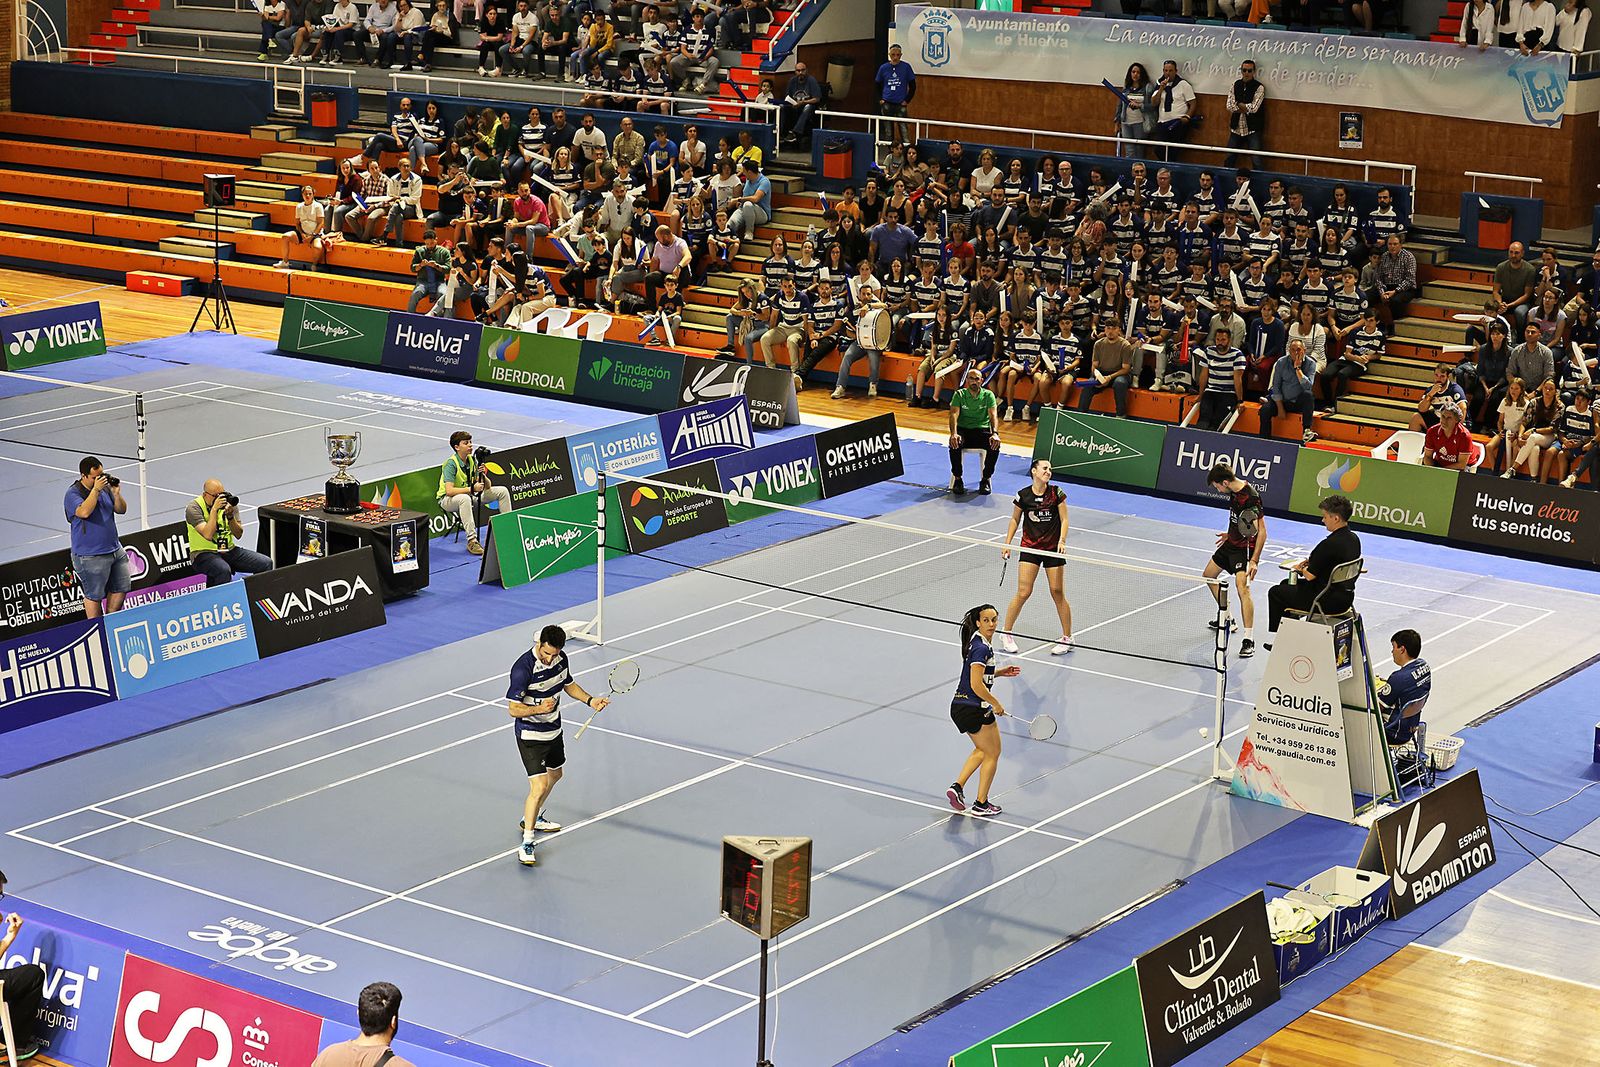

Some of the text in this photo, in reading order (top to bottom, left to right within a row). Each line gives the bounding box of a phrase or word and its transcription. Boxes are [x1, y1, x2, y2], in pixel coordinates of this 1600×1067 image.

[966, 16, 1070, 33] Ayuntamiento
[994, 33, 1069, 48] de Huelva
[1105, 24, 1465, 80] La emoción de ganar debe ser mayor
[1182, 56, 1203, 75] al
[1270, 62, 1289, 86] de
[43, 319, 97, 349] YONEX
[395, 324, 462, 355] Huelva
[435, 354, 459, 366] original
[615, 361, 671, 380] Fundación
[492, 367, 565, 391] IBERDROLA
[613, 373, 653, 392] Unicaja
[751, 400, 782, 410] ESPAÑA
[601, 432, 658, 459] LOTERÍAS
[826, 433, 892, 467] OKEYMAS
[1055, 433, 1121, 456] El Corte Inglés
[509, 454, 560, 481] Andalucía
[611, 461, 623, 470] CON
[631, 453, 655, 464] DEPORTE
[828, 452, 895, 479] FITNESS CLUB
[1176, 441, 1271, 481] Huelva
[511, 474, 564, 492] Región Europea del
[760, 456, 815, 496] YONEX
[513, 488, 546, 501] DEPORTE
[665, 497, 714, 517] Región Europea del
[667, 511, 698, 526] DEPORTE
[1351, 501, 1426, 528] RDROLA
[1475, 492, 1579, 524] Huelva eleva
[525, 527, 581, 551] El Corte Inglés
[1471, 513, 1576, 544] tus sentidos.
[6, 585, 85, 618] DE HUELVA
[264, 574, 374, 619] VANDA
[9, 607, 58, 628] OBJETIVOS
[157, 602, 244, 640] LOTERÍAS
[285, 604, 349, 626] vinilos del sur
[18, 643, 37, 654] AGUAS
[27, 647, 51, 659] HUELVA
[171, 629, 237, 654] CON EL DEPORTE
[1267, 686, 1332, 716] Gaudia
[1256, 713, 1340, 739] Servicios Jurídicos
[1255, 743, 1336, 767] www.gaudia.com.es
[1272, 737, 1286, 746] +34
[1288, 738, 1303, 749] 959
[1304, 742, 1315, 751] 26
[1316, 744, 1325, 753] 13
[1326, 747, 1337, 756] 86
[1458, 826, 1487, 849] ESPAÑA
[1411, 842, 1493, 905] BADMINTON
[1342, 897, 1385, 942] Andalucía
[1164, 955, 1261, 1034] Clínica Dental
[1182, 995, 1253, 1044] Valverde & Bolado
